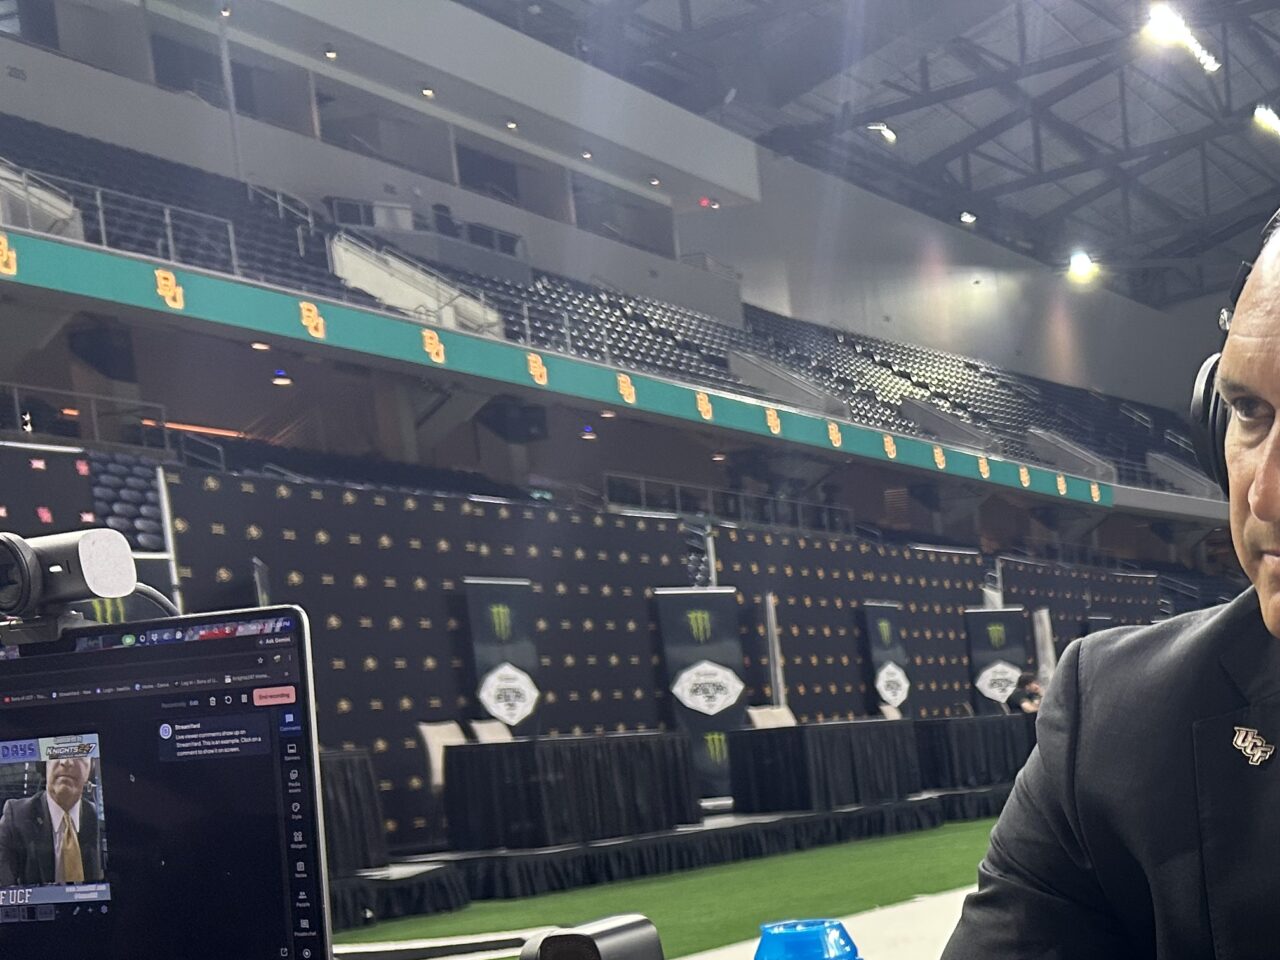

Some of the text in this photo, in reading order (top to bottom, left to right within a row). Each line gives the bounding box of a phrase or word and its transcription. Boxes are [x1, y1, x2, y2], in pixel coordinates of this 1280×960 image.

[154, 268, 184, 309] BU
[300, 301, 326, 340] BU
[421, 328, 446, 365] BU
[2, 743, 36, 757] DAYS
[1233, 726, 1274, 765] UCF
[10, 889, 32, 903] UCF
